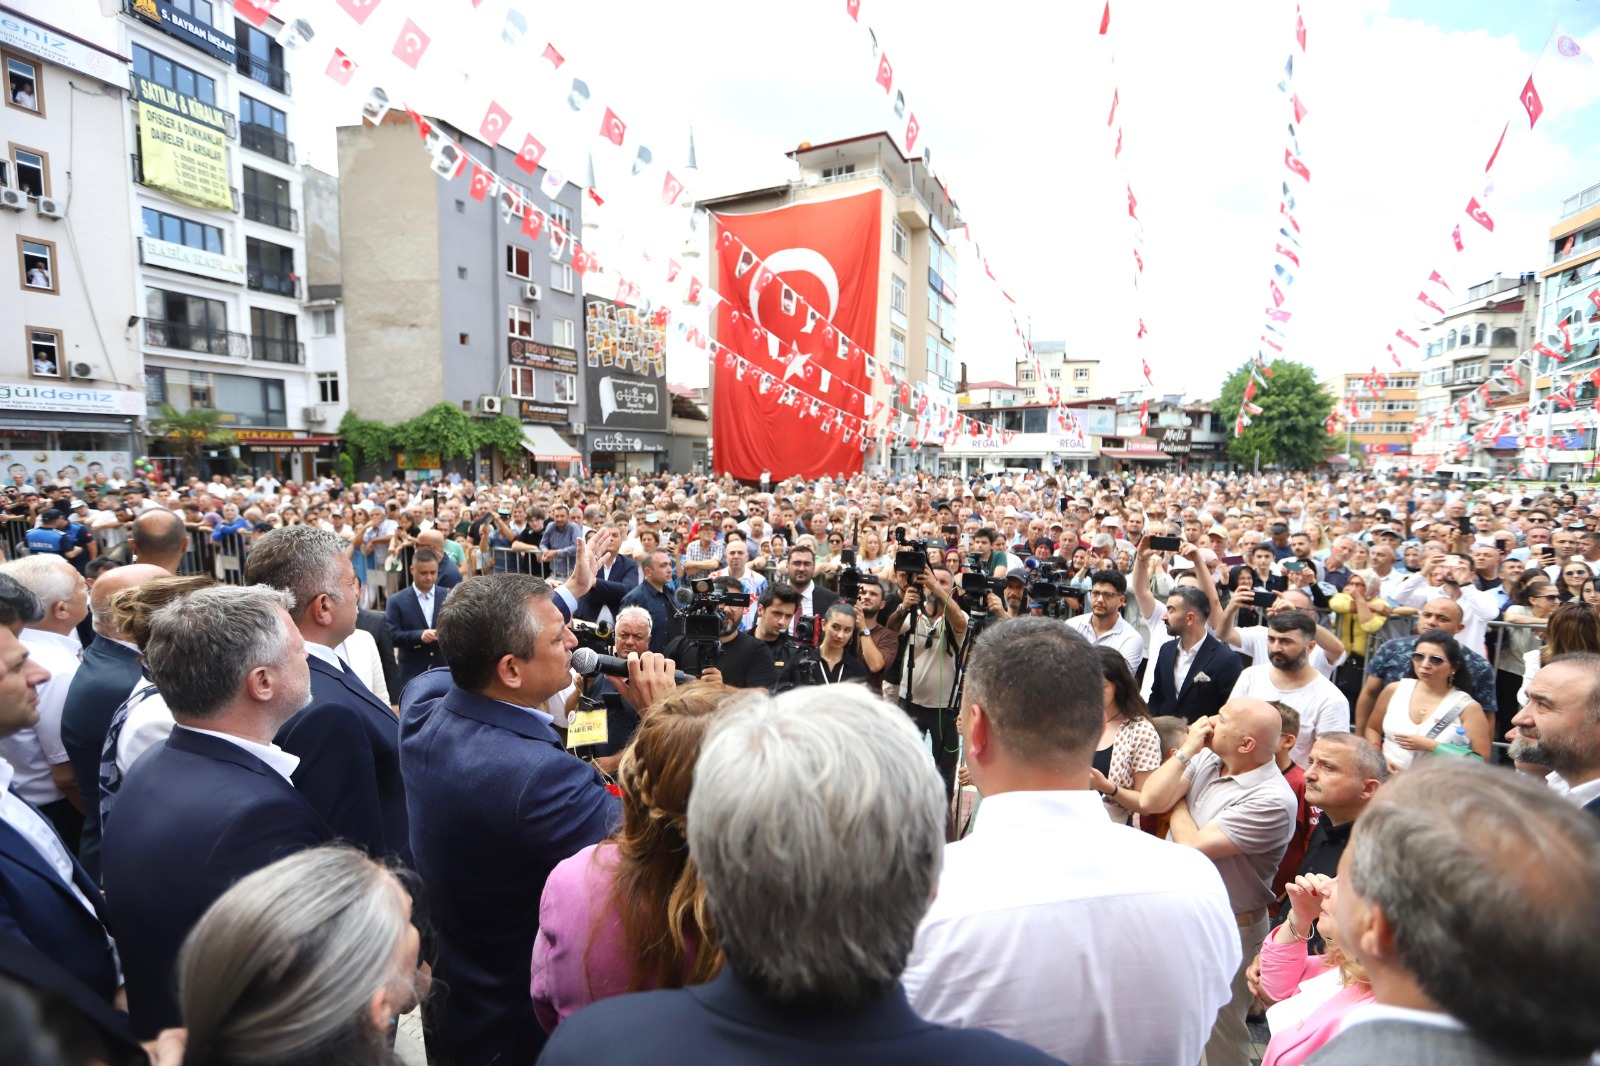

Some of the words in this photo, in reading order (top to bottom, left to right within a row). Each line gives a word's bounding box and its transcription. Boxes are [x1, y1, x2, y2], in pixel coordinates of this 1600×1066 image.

[0, 19, 68, 53] eniz
[161, 8, 171, 21] S.
[171, 13, 207, 40] BAYRAM
[207, 30, 236, 55] İNŞAAT
[140, 78, 180, 112] SATILIK
[179, 94, 189, 115] &
[187, 96, 226, 129] KİRALIK
[183, 123, 223, 147] DÜKKANLAR
[193, 142, 223, 162] ARSALAR
[524, 342, 549, 356] ERDEM
[0, 386, 113, 403] güldeniz
[593, 434, 643, 452] GUSTO
[1059, 438, 1087, 449] REGAL
[1163, 428, 1188, 442] Melis
[971, 439, 1000, 449] REGAL
[569, 725, 593, 734] HABER
